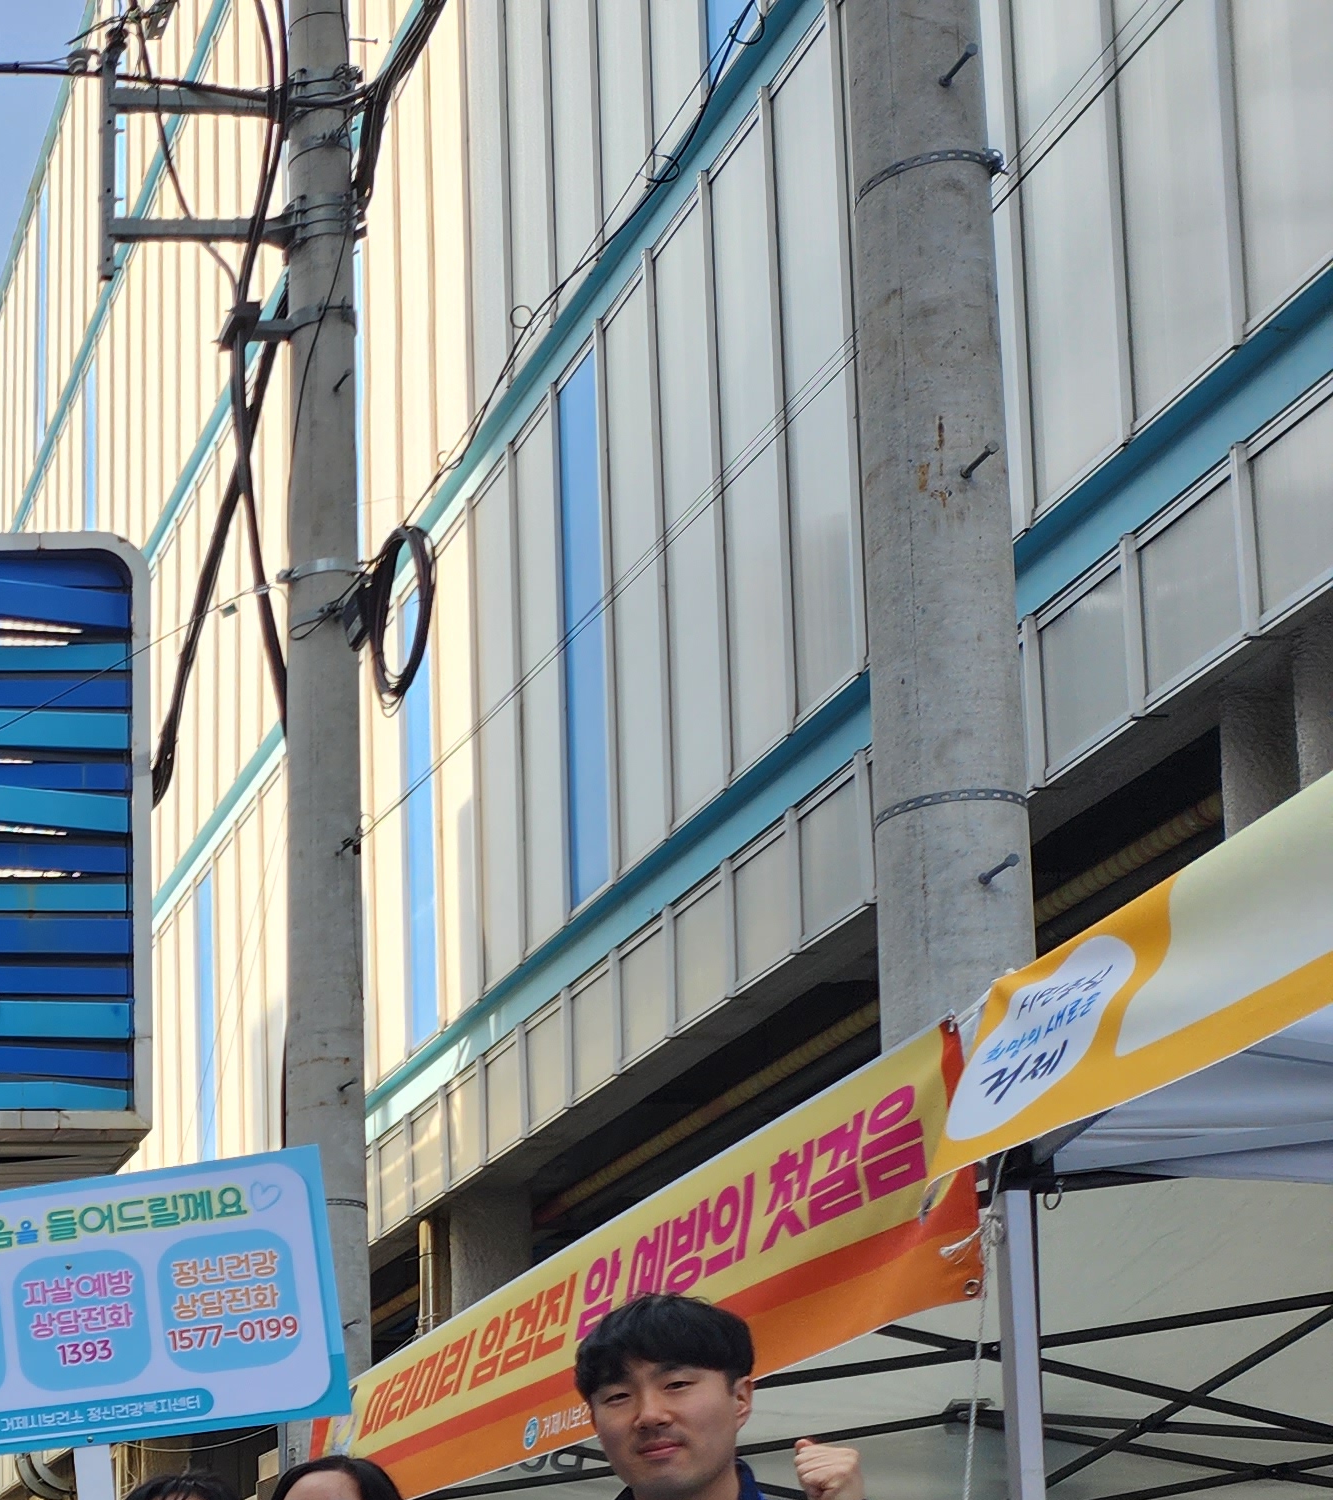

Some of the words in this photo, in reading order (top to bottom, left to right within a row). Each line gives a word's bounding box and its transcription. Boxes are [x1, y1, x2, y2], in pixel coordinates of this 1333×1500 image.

[979, 1039, 1069, 1105] 거제
[45, 1183, 249, 1243] 들어드릴께요
[171, 1249, 279, 1288] 정신건강
[357, 1328, 477, 1441] 미리미리
[468, 1271, 579, 1390] 암검진
[625, 1171, 755, 1303] 예방의
[759, 1084, 928, 1254] 첫걸음
[22, 1269, 135, 1308] 자살예방
[172, 1282, 280, 1322] 상담전화
[29, 1302, 134, 1340] 상담전화
[167, 1315, 299, 1353] 1577-0199
[56, 1338, 113, 1367] 1393
[0, 1407, 85, 1434] 거제시보건소
[86, 1393, 201, 1426] 정신건강복지센터
